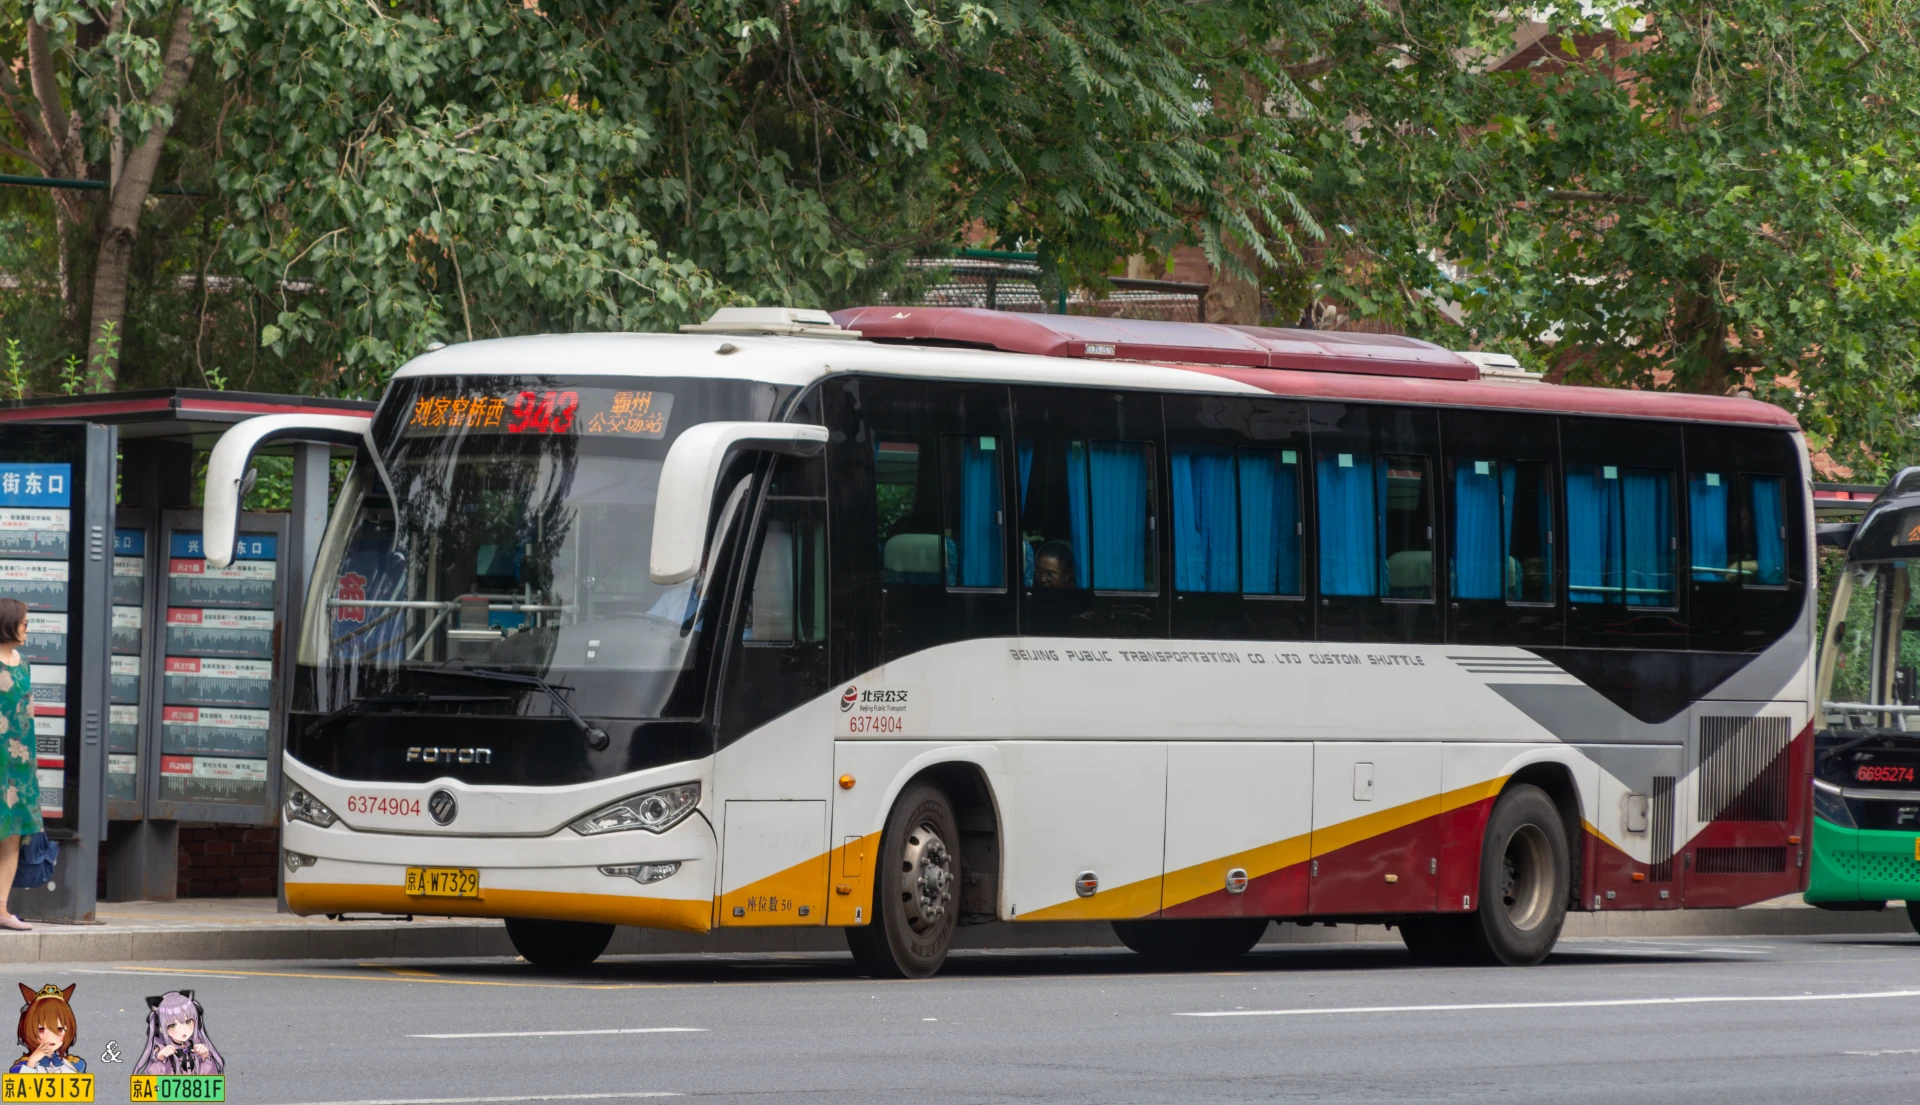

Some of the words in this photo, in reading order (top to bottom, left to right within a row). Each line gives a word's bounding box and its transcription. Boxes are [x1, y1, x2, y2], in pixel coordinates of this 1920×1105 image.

[610, 391, 653, 413] 霸州
[409, 396, 507, 427] 刘家窑桥西
[507, 391, 579, 434] 943
[588, 411, 665, 433] 公交场站
[2, 472, 64, 495] 街东口
[1009, 649, 1060, 661] BEIJING
[1065, 650, 1113, 662] PUBLIC
[1119, 651, 1241, 664] TRANSPORTATION
[1308, 653, 1362, 665] CUSTOM
[1367, 654, 1426, 666] SHUTTLE
[860, 690, 909, 703] 北京公交
[860, 704, 873, 713] Beijing
[887, 705, 907, 713] Transport
[850, 716, 902, 733] 6374904
[406, 747, 492, 764] FOTON
[1857, 765, 1914, 782] 6695274
[347, 796, 421, 817] 6374904
[747, 896, 778, 913] 座位数
[781, 898, 793, 912] 50
